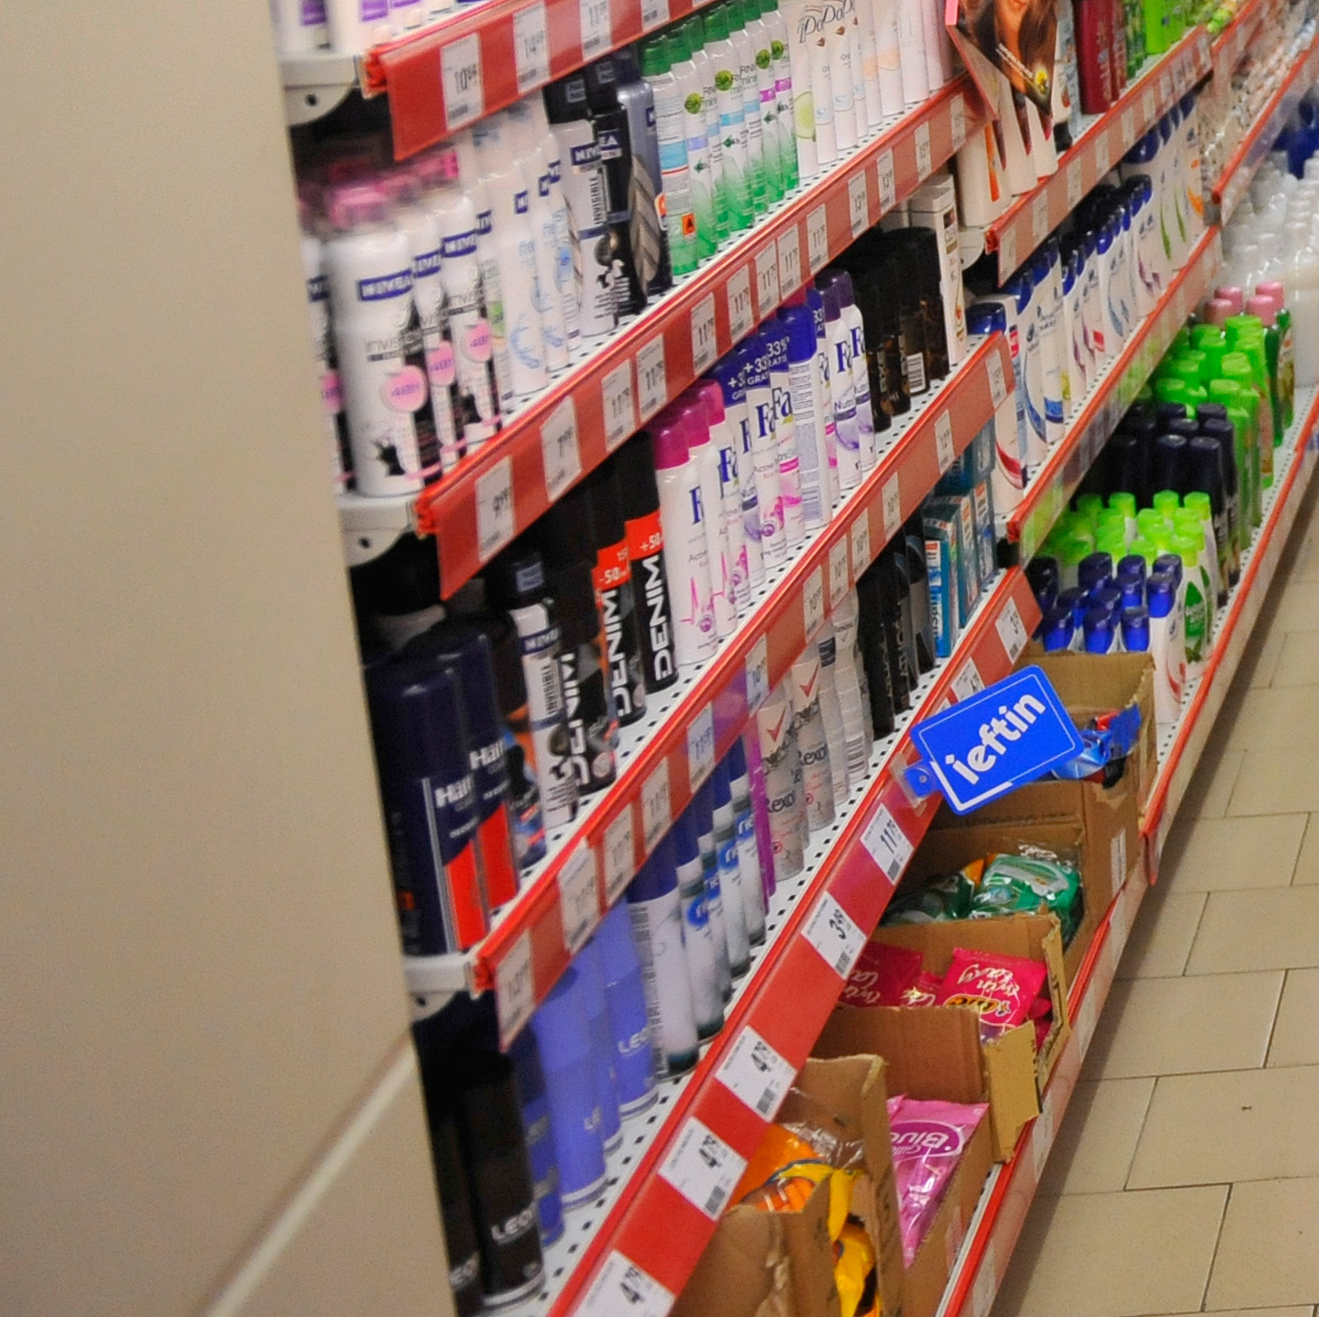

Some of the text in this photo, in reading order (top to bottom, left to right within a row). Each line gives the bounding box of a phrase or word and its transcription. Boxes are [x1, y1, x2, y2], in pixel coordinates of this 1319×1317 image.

[589, 176, 602, 226] INVISIBLE
[603, 588, 631, 717] DENIM
[642, 553, 671, 683] DENIM
[797, 743, 829, 766] Rexo
[944, 689, 1047, 786] ieftin
